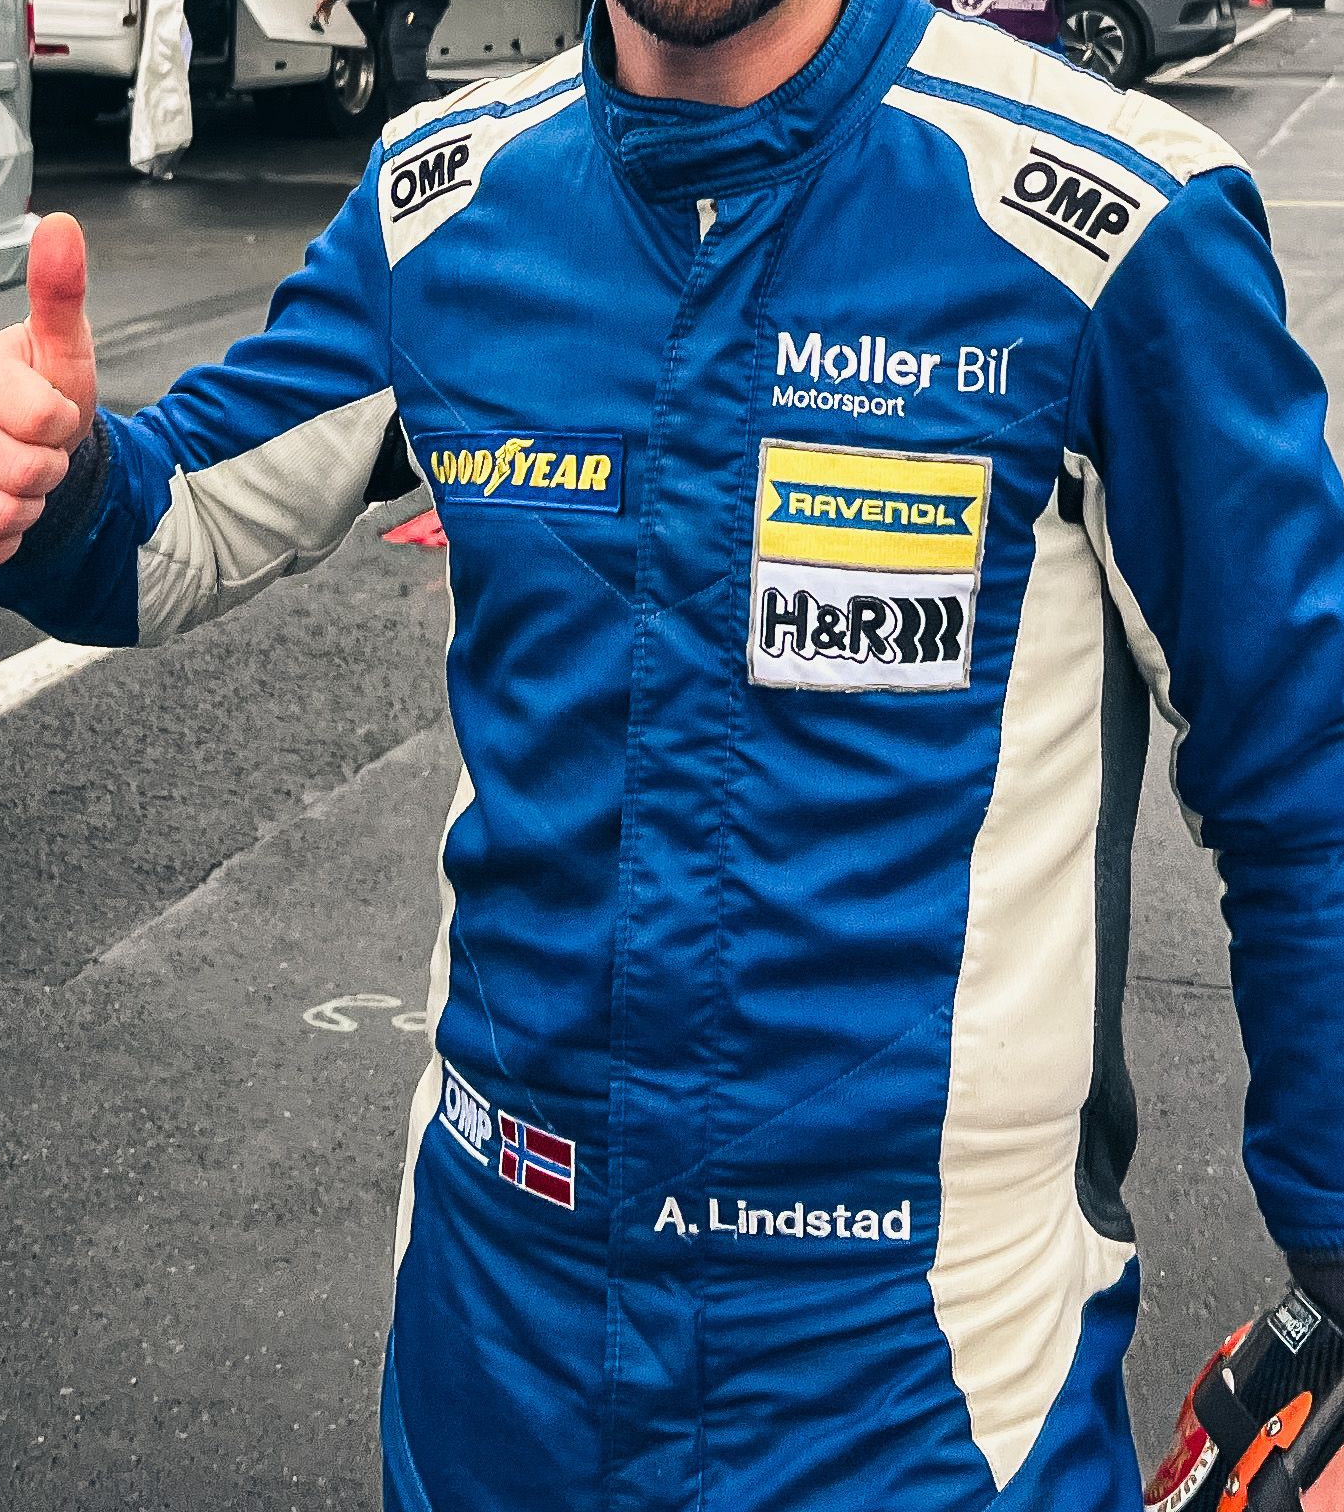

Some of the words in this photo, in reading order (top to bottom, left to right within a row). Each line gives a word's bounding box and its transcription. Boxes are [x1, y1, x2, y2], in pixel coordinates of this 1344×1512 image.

[391, 144, 470, 209] OMP
[1013, 162, 1131, 241] OMP
[957, 346, 1010, 395] Bil
[772, 386, 905, 418] Motorsport
[788, 492, 956, 527] RAVENOL
[445, 1076, 492, 1149] OMP
[654, 1197, 699, 1236] A.
[709, 1199, 911, 1240] Lindstad
